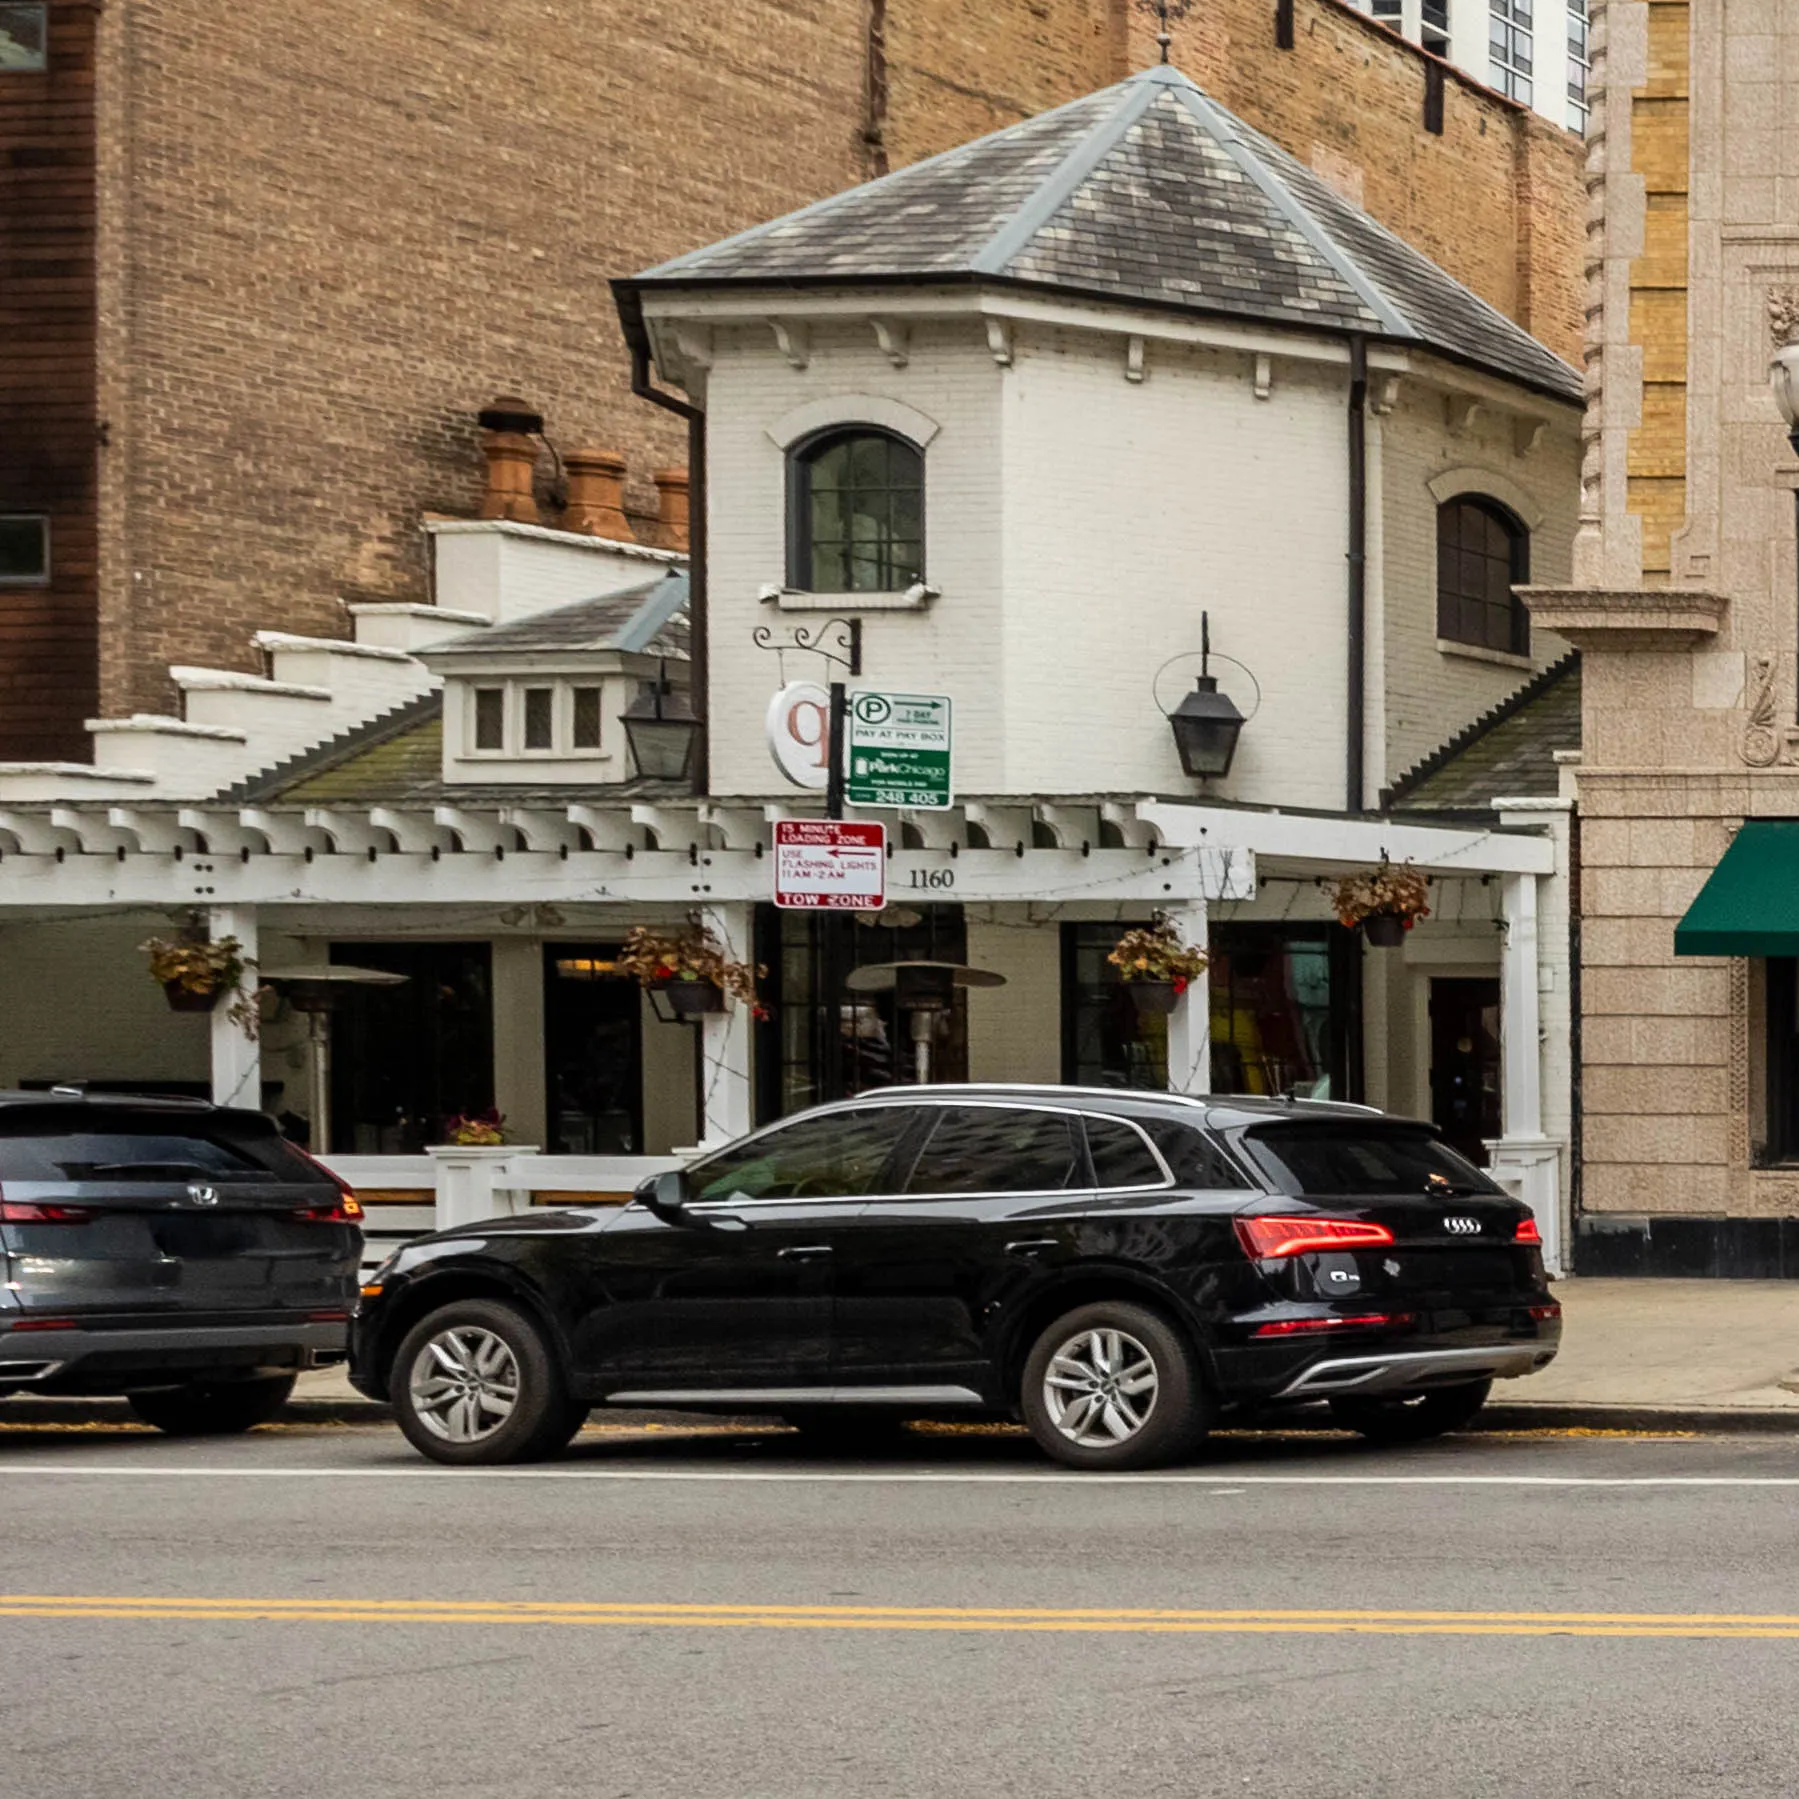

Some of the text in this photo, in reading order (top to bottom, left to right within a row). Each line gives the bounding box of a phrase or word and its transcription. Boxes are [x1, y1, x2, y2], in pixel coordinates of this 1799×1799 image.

[856, 729, 876, 738] PAY
[879, 730, 892, 738] AT
[921, 732, 945, 742] BOX
[876, 790, 939, 805] 248 405
[781, 823, 841, 835] 15 MINUTE
[781, 834, 867, 846] LOADING ZONE
[782, 860, 877, 871] FLASHING LIGHTS
[910, 869, 954, 889] 1160
[782, 893, 874, 907] TOW ZONE
